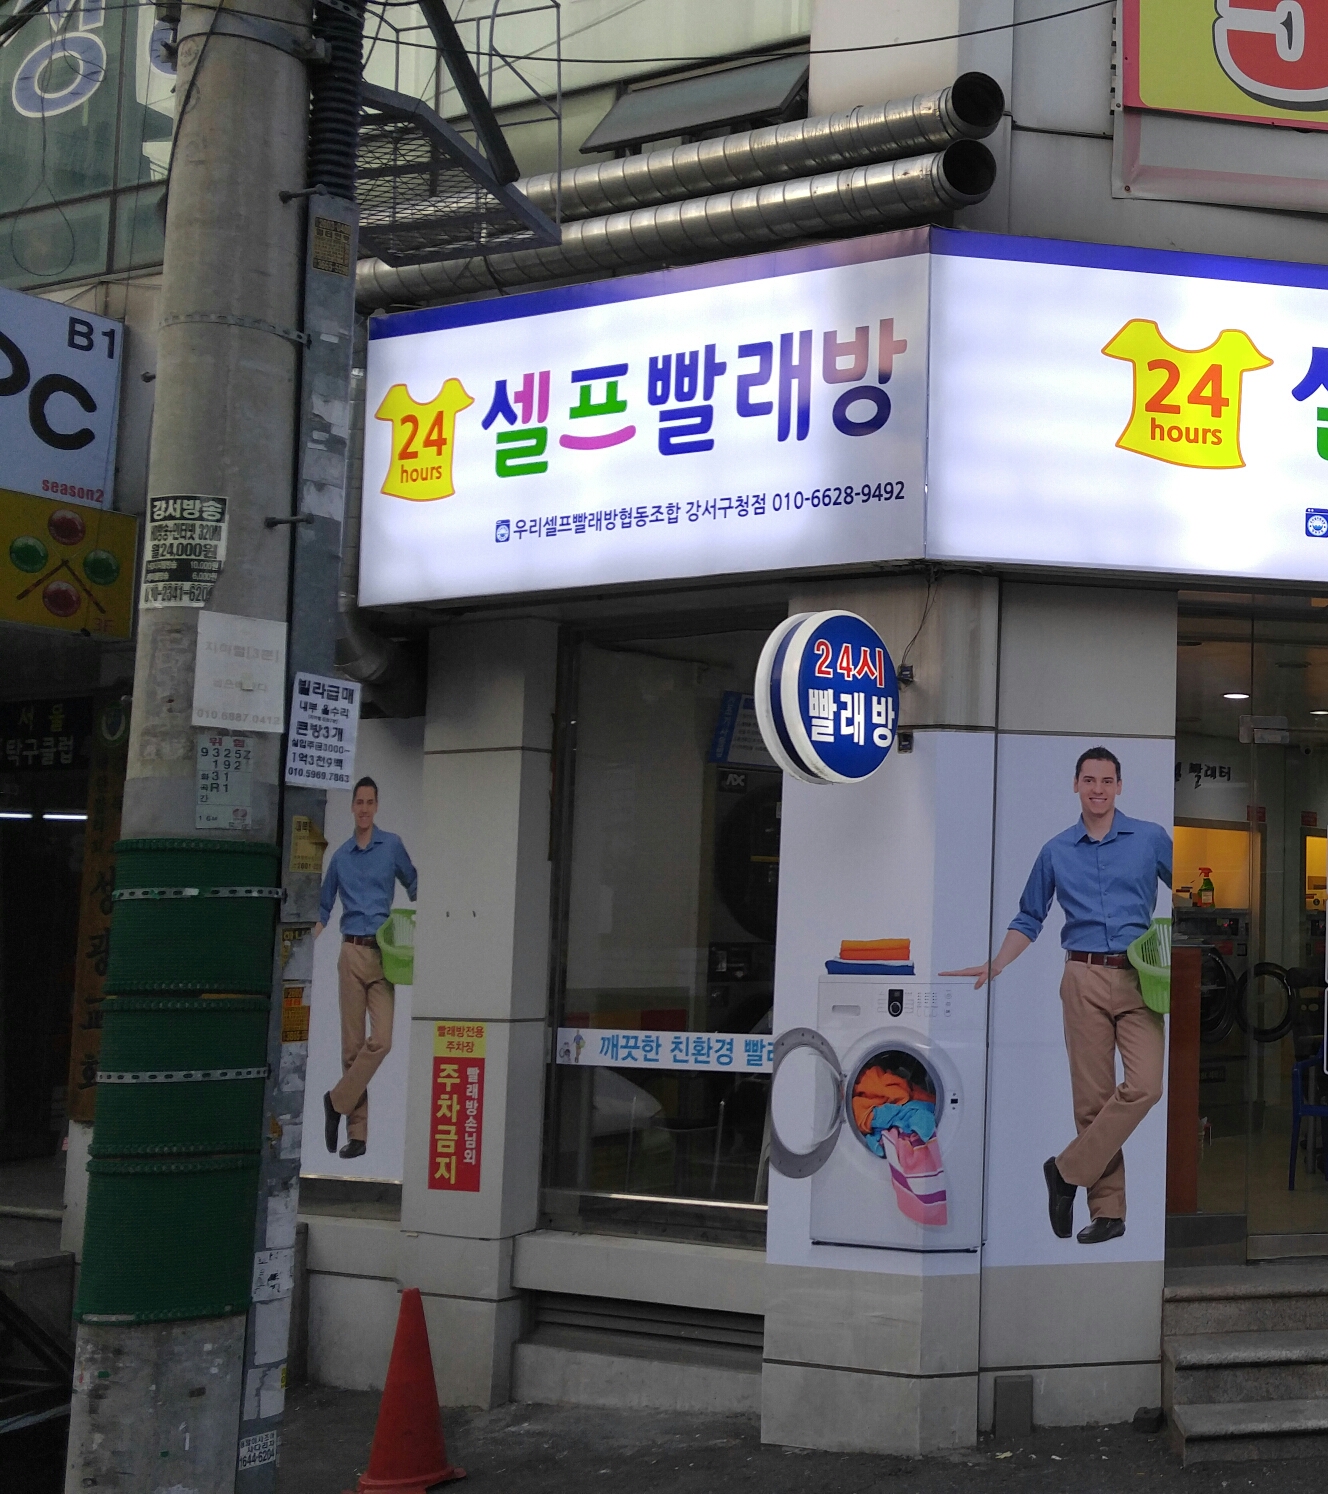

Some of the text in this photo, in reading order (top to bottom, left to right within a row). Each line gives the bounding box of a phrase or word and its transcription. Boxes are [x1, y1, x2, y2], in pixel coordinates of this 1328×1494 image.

[67, 316, 116, 359] B1
[481, 318, 908, 478] 셀프빨래방
[1144, 358, 1230, 419] 24
[398, 413, 448, 461] 24
[1150, 418, 1222, 446] hours
[399, 464, 443, 484] hours
[41, 478, 104, 503] season2
[153, 500, 222, 520] 강서방송
[513, 480, 905, 540] 우리셀프빨래방협동조합 강서구청점 010-6628-9492
[814, 639, 884, 688] 24시
[298, 678, 354, 704] 빌라급매
[300, 700, 318, 713] 내부
[296, 720, 344, 742] 큰방3개
[808, 688, 895, 748] 빨래방
[436, 1025, 485, 1040] 빨래방전용
[446, 1040, 475, 1053] 주차장
[598, 1033, 662, 1064] 깨끗한
[670, 1035, 735, 1065] 친환경
[434, 1063, 461, 1185] 주차금지
[463, 1066, 480, 1165] 빨래방손님외
